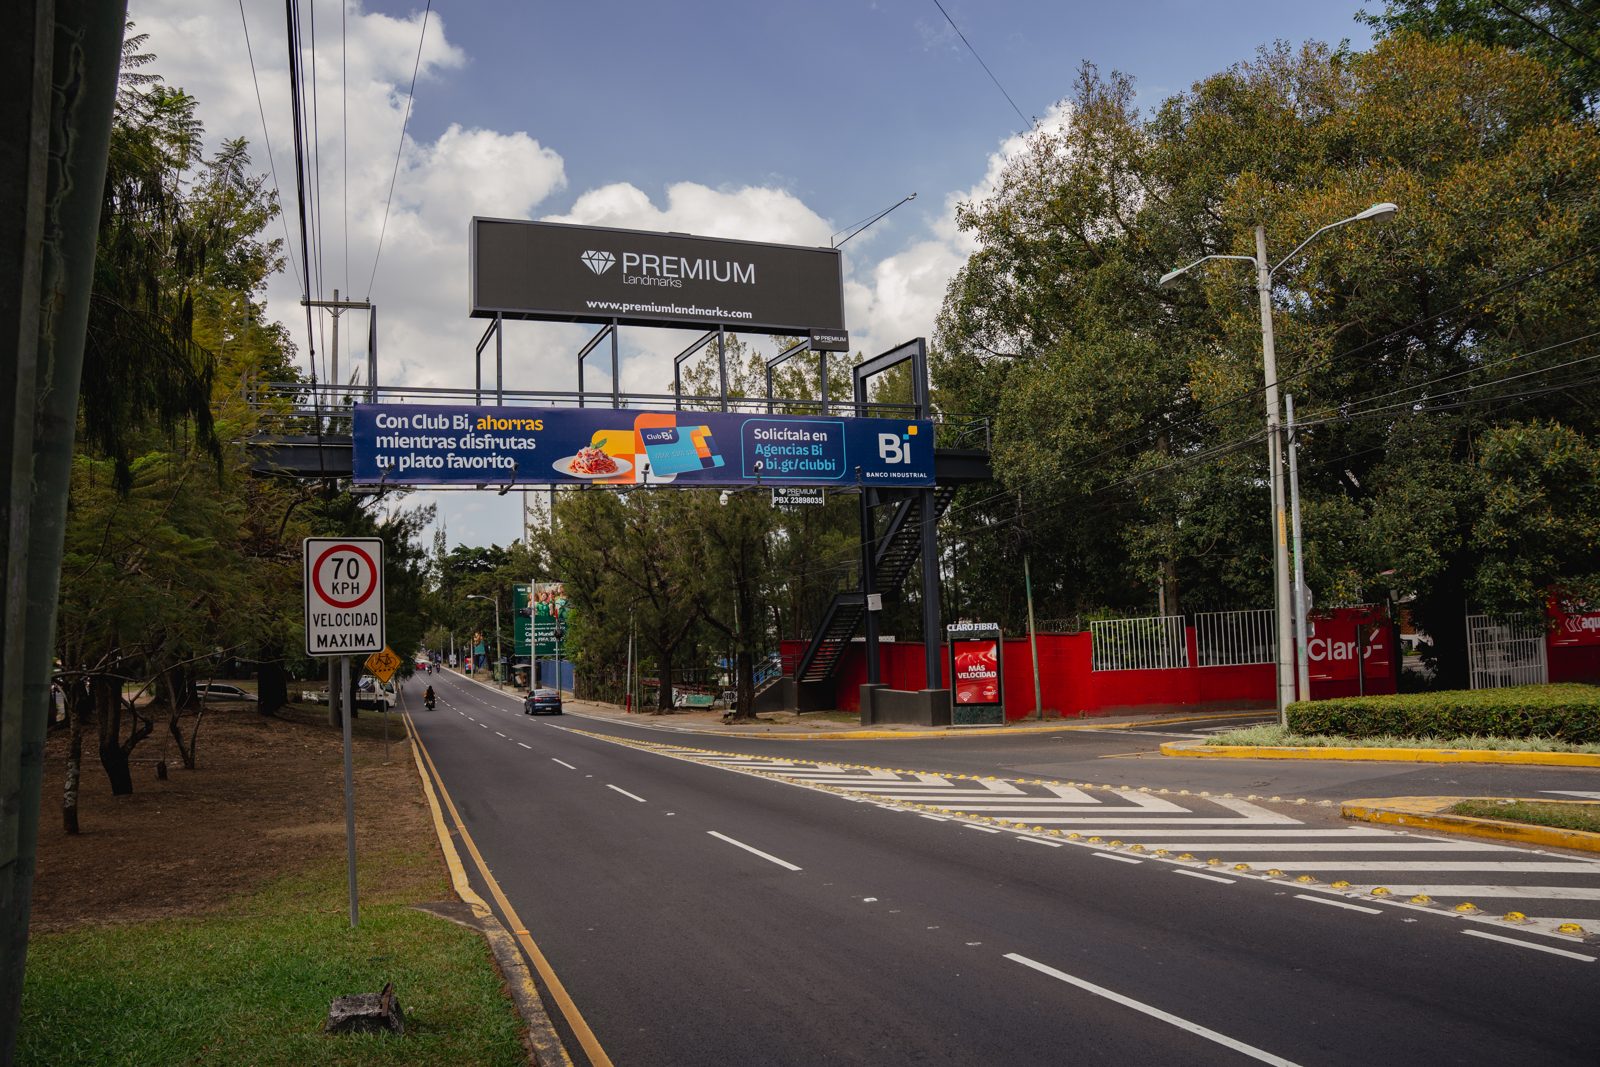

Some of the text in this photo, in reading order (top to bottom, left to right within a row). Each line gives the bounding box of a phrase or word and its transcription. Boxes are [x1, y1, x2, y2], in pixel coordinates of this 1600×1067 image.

[622, 252, 756, 284] PREMIUM
[623, 274, 682, 288] Landmarks
[586, 301, 752, 319] www.premiumlandmarks.com
[375, 413, 544, 432] Con Club Bi, ahorras
[376, 432, 536, 450] mientras disfrutas
[661, 430, 673, 440] Bi
[754, 427, 828, 441] Solicítala en
[755, 443, 823, 457] Agencias Bi
[878, 425, 918, 464] Bi
[375, 452, 515, 471] tu plato favorito
[765, 458, 836, 473] bi.gt/clubbi
[774, 496, 823, 504] PBX 23898035
[331, 558, 360, 580] 70
[331, 582, 360, 595] KPH
[312, 612, 378, 627] VELOCIDAD
[946, 622, 999, 631] CLARO FIBRA
[317, 633, 376, 648] MAXIMA
[957, 671, 997, 679] VELOCIDAD
